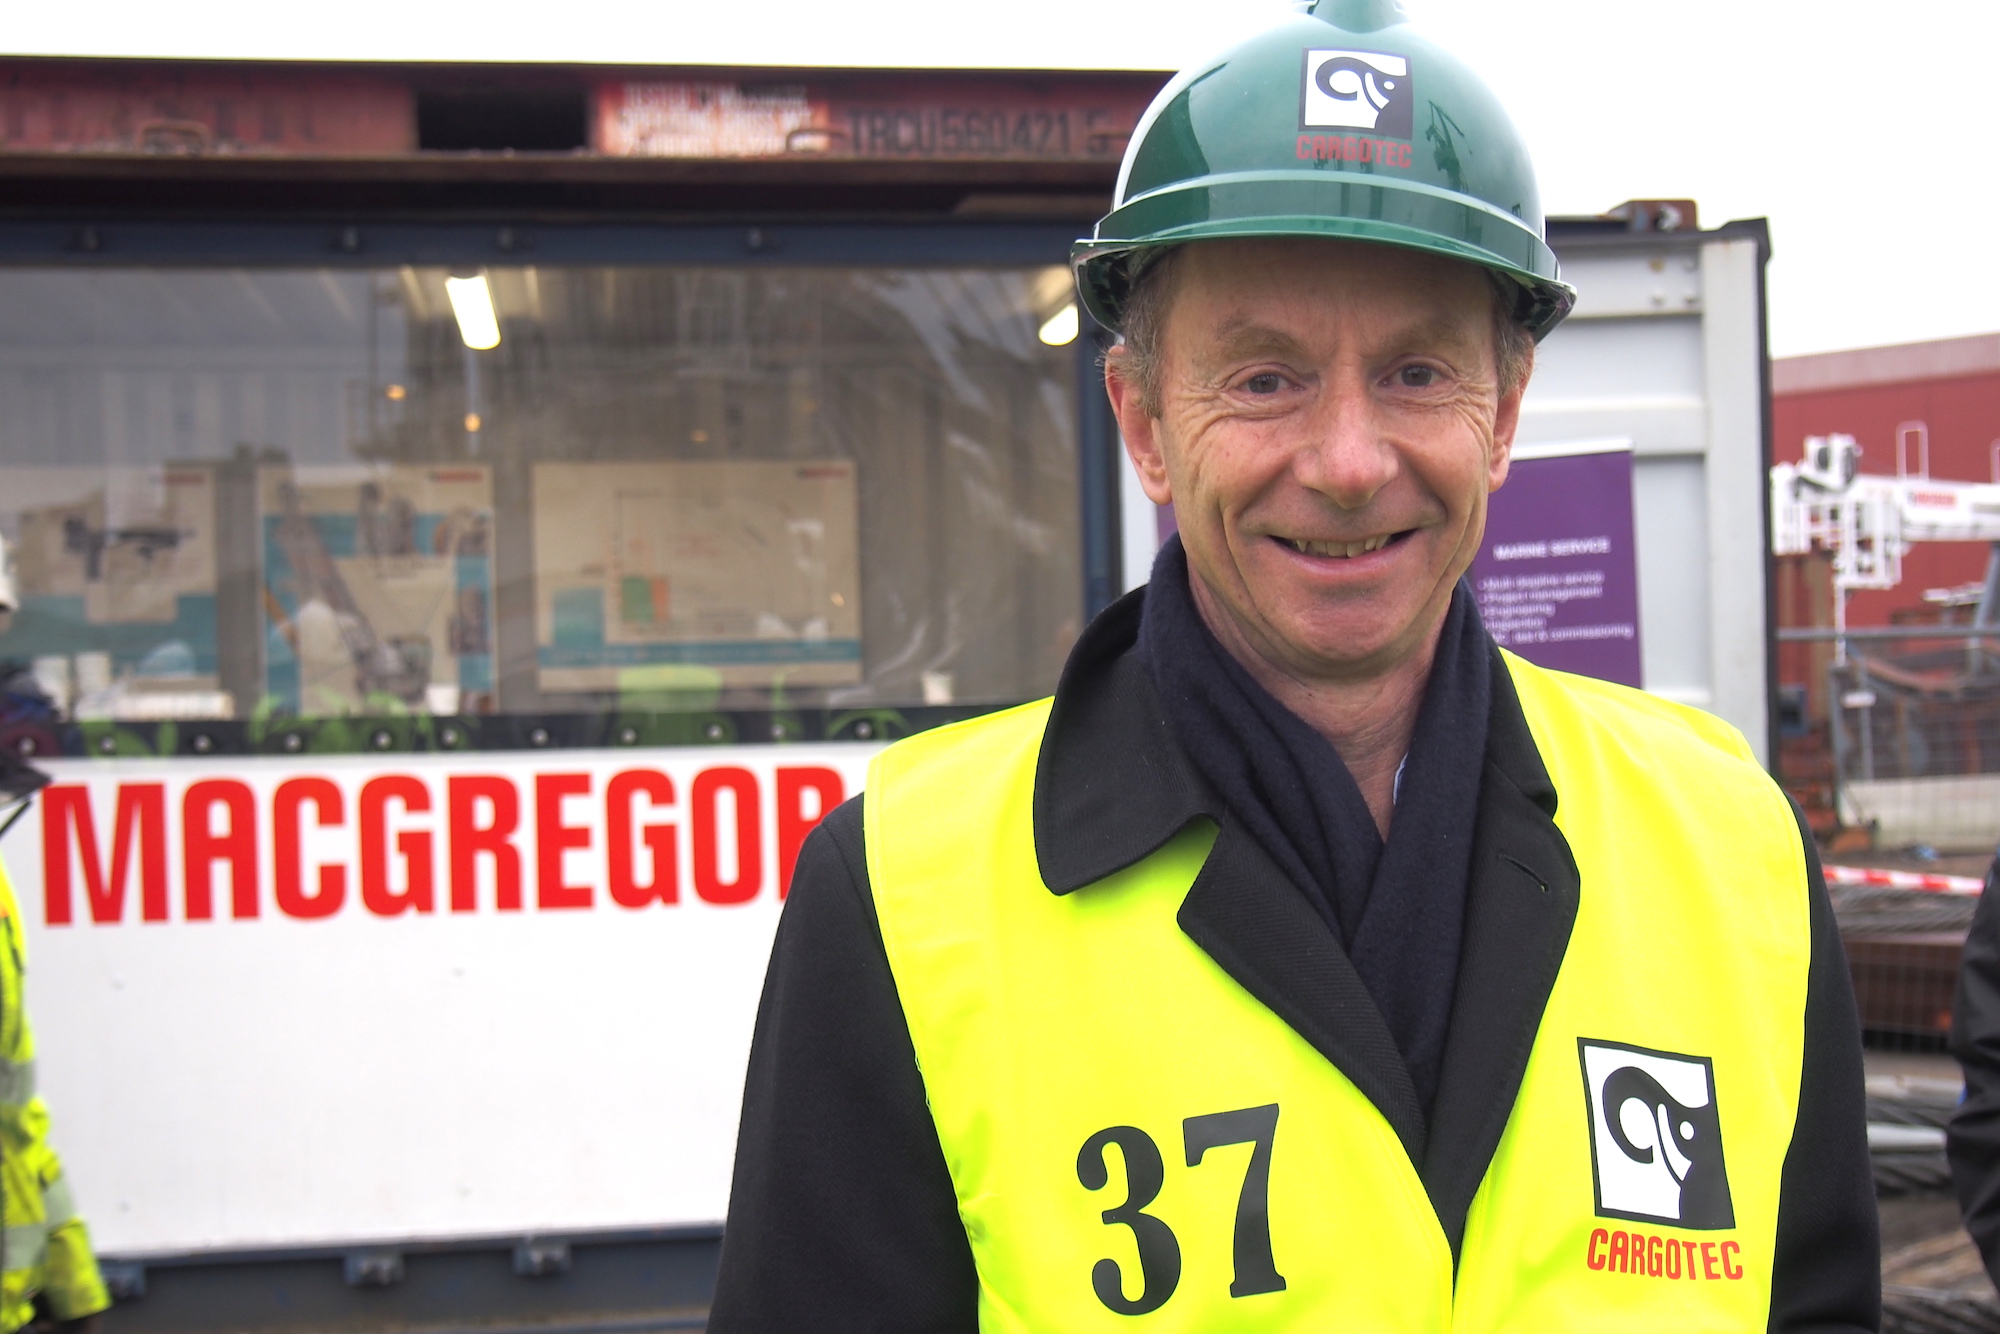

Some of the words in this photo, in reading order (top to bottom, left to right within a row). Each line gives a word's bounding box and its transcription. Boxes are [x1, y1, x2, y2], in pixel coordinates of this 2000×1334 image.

[1296, 135, 1412, 168] CARGOTEC
[1493, 541, 1548, 560] MARINE
[1549, 537, 1611, 556] SERVICE
[1077, 1103, 1287, 1316] 37
[1587, 1228, 1743, 1281] CARGOTEC
